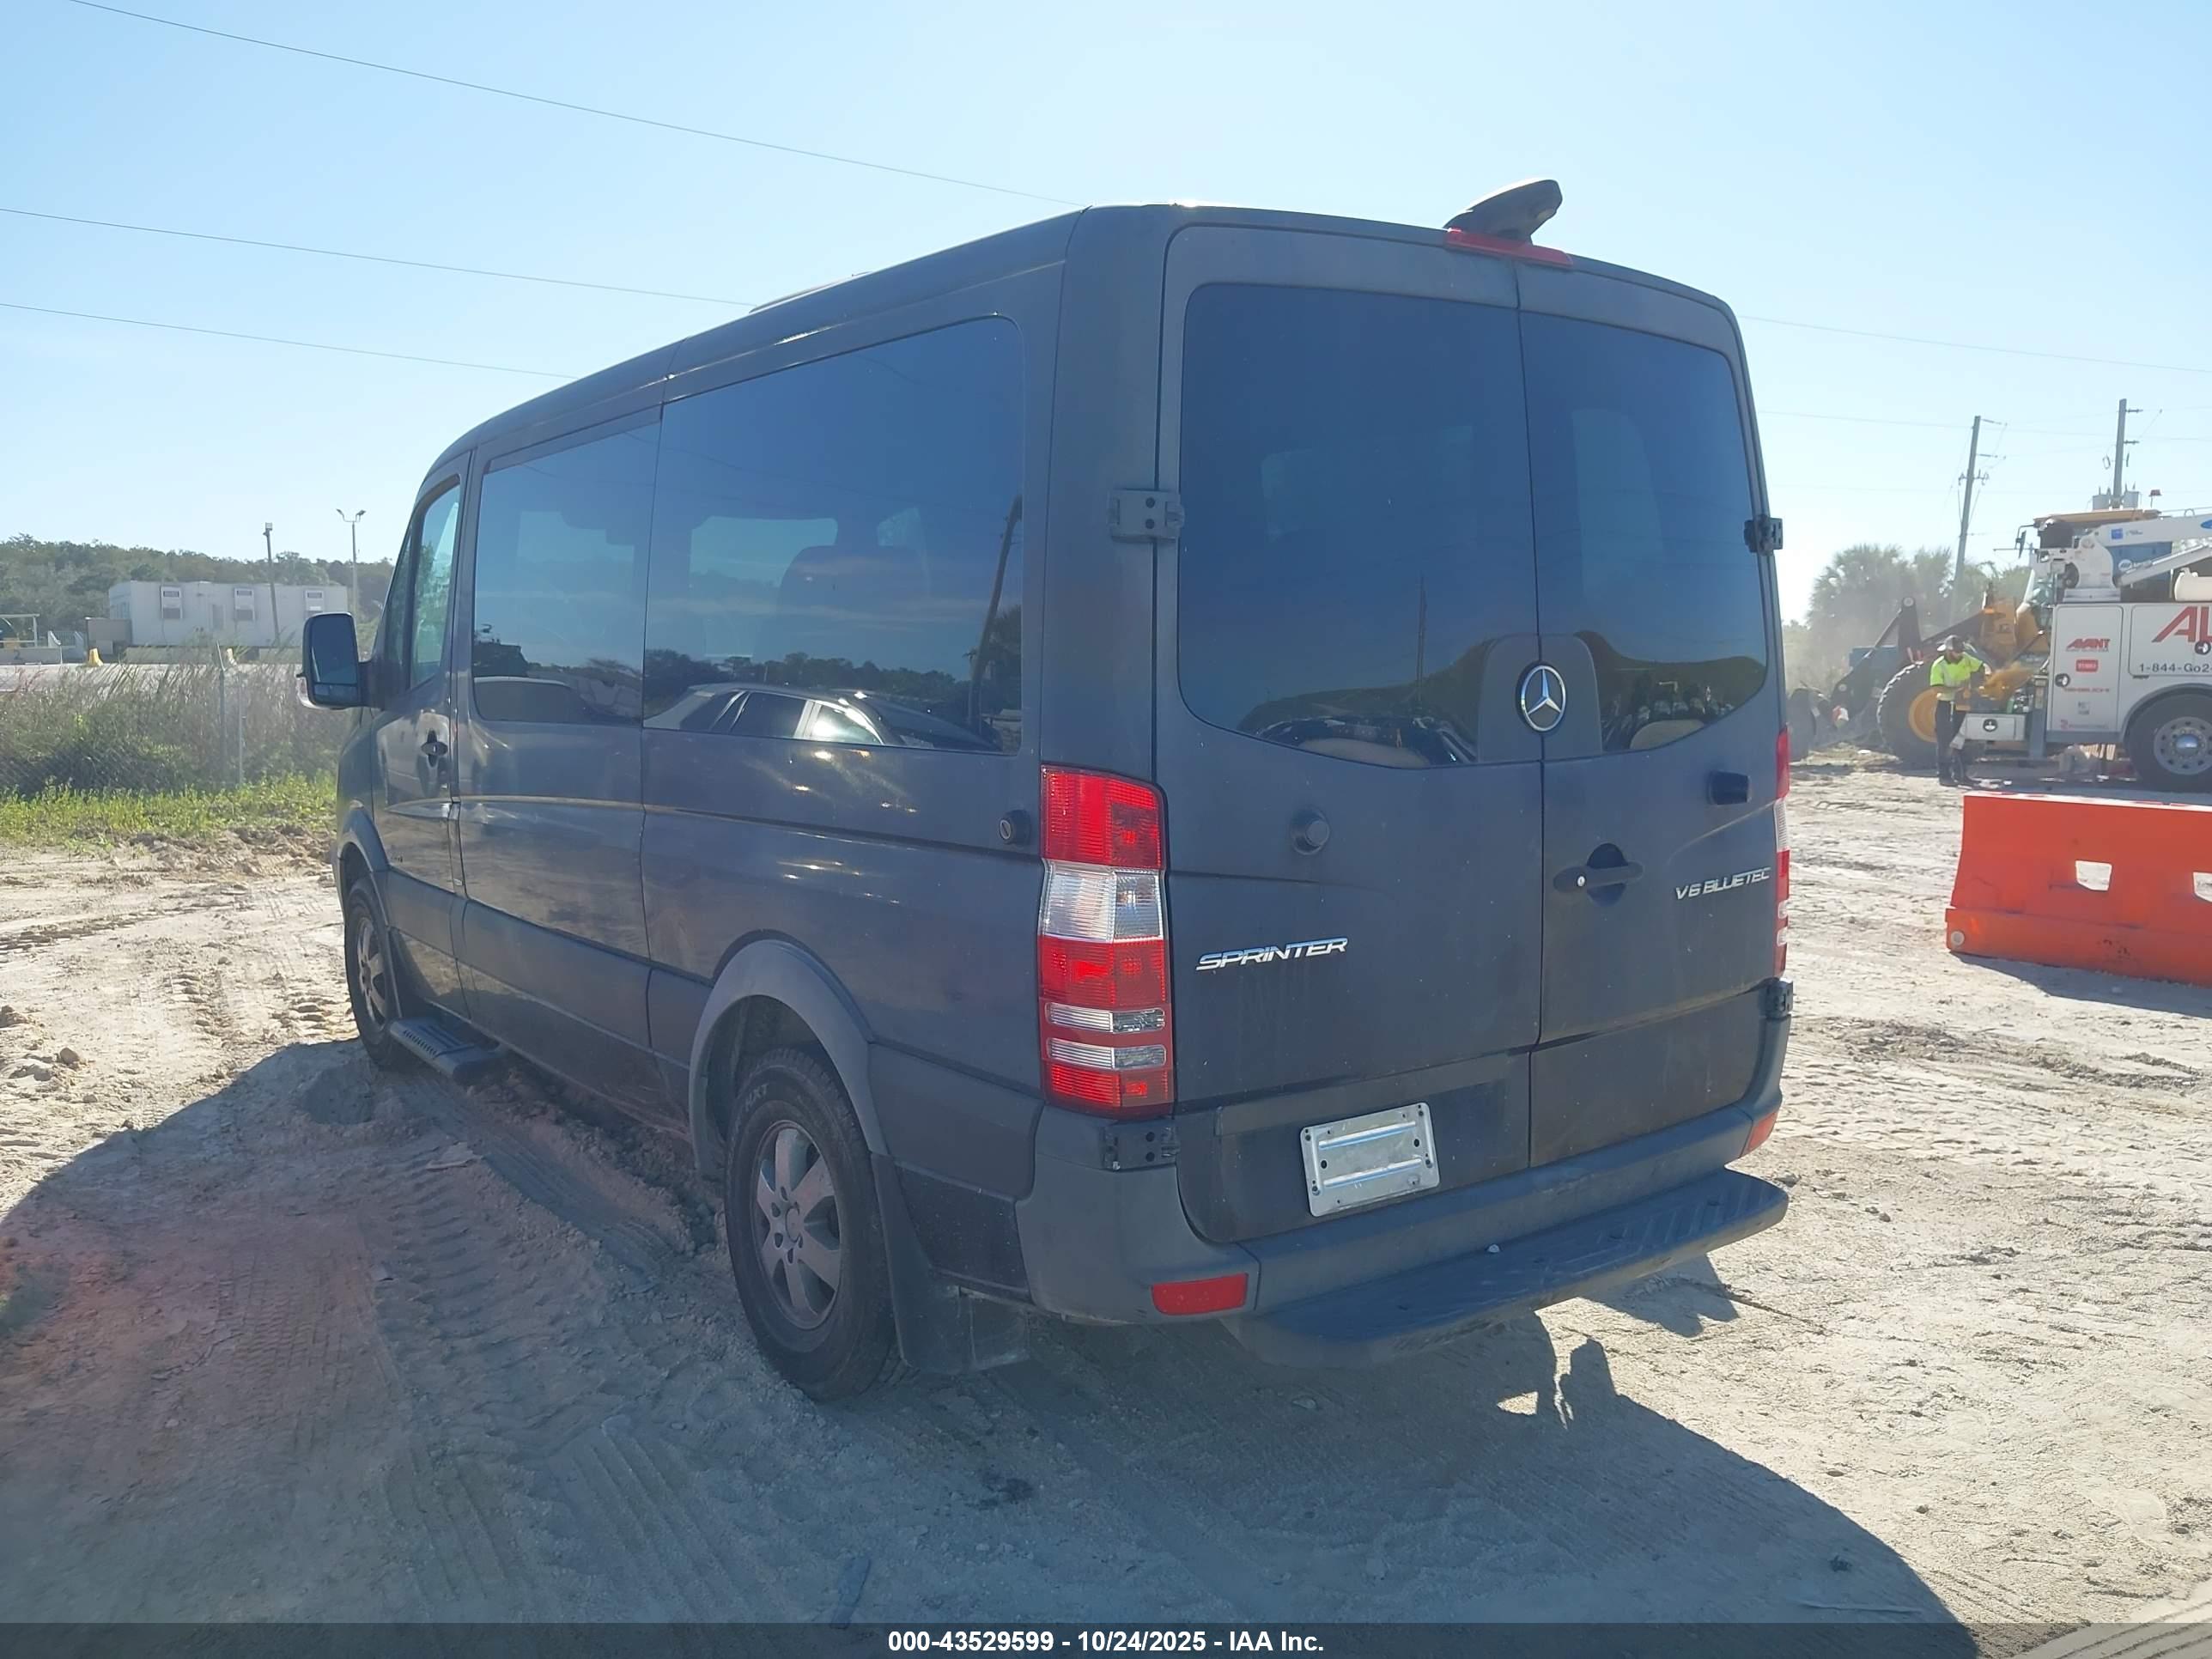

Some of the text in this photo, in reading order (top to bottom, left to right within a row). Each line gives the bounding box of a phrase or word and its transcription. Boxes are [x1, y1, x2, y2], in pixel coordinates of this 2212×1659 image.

[1675, 866, 1771, 900] V6 BLUETEC
[1195, 937, 1348, 971] SPRINTER
